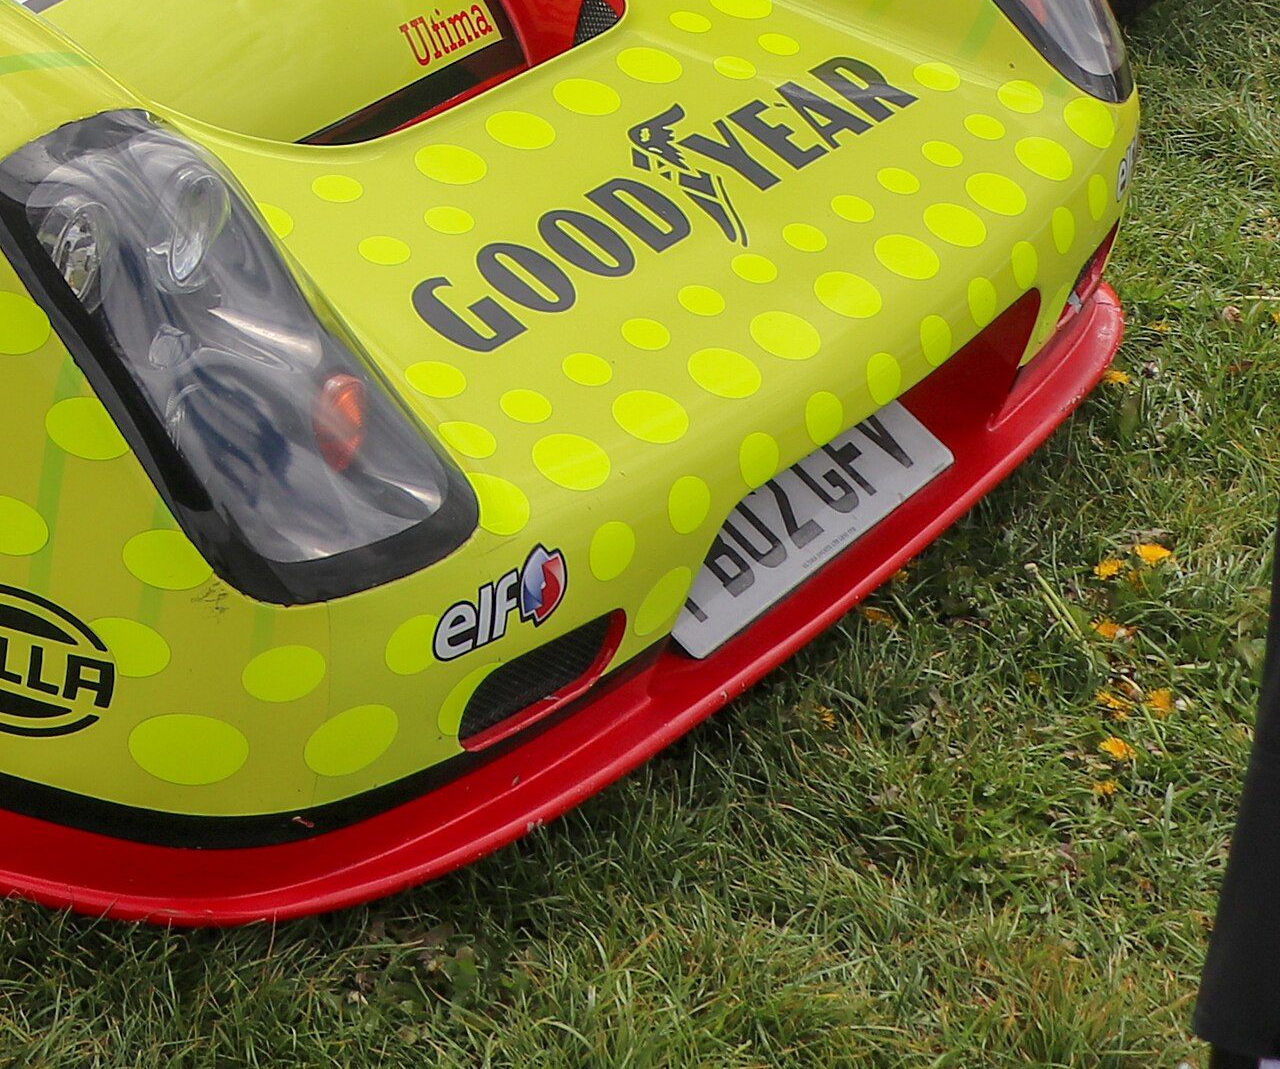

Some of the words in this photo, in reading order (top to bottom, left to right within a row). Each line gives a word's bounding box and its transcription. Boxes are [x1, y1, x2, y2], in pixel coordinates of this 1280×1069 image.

[398, 1, 494, 67] Ultima
[684, 478, 825, 624] B02
[433, 580, 520, 662] elf
